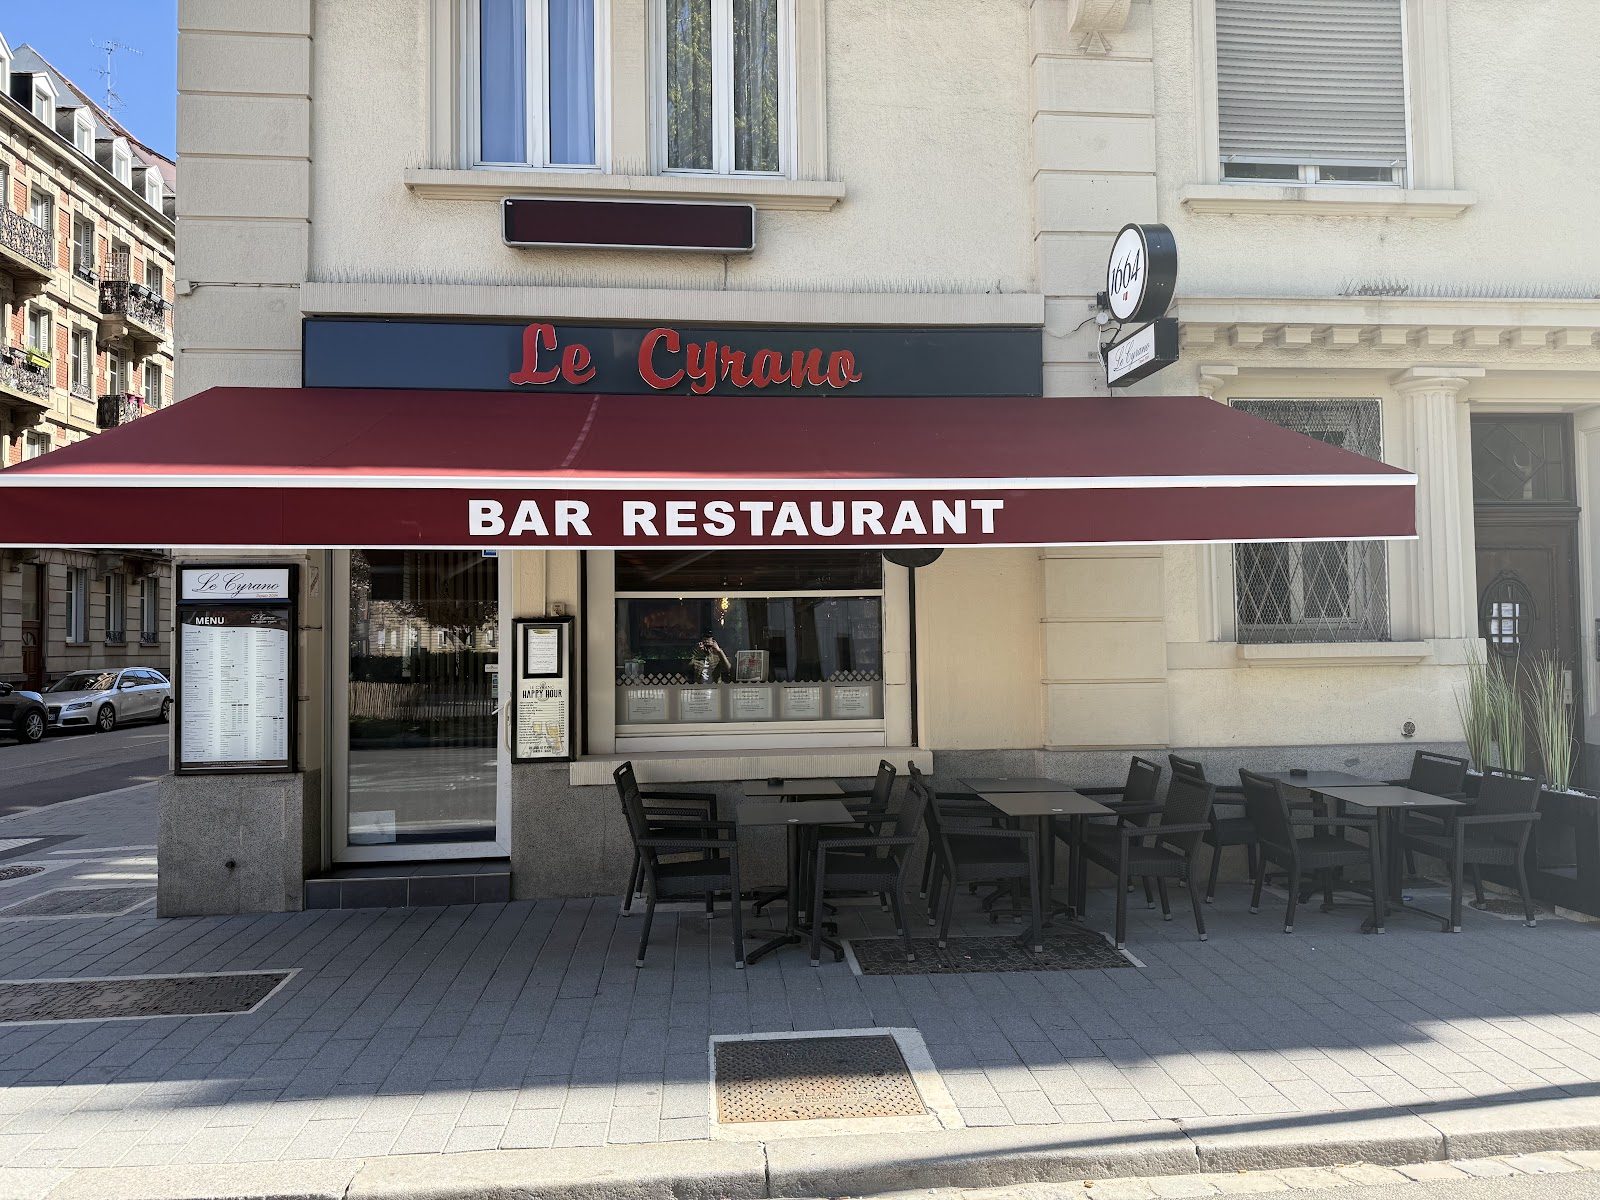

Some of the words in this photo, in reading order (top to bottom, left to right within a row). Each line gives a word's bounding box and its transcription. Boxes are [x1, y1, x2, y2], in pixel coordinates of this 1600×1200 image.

[1110, 248, 1141, 296] 1664
[509, 322, 597, 387] Le
[637, 327, 863, 395] Cyrano
[467, 499, 592, 537] BAR
[622, 498, 1005, 537] RESTAURANT
[192, 572, 219, 592] Le
[222, 572, 280, 598] Cyrano
[195, 616, 225, 625] MENU
[522, 689, 544, 699] HAPPY
[545, 689, 563, 698] HOUR
